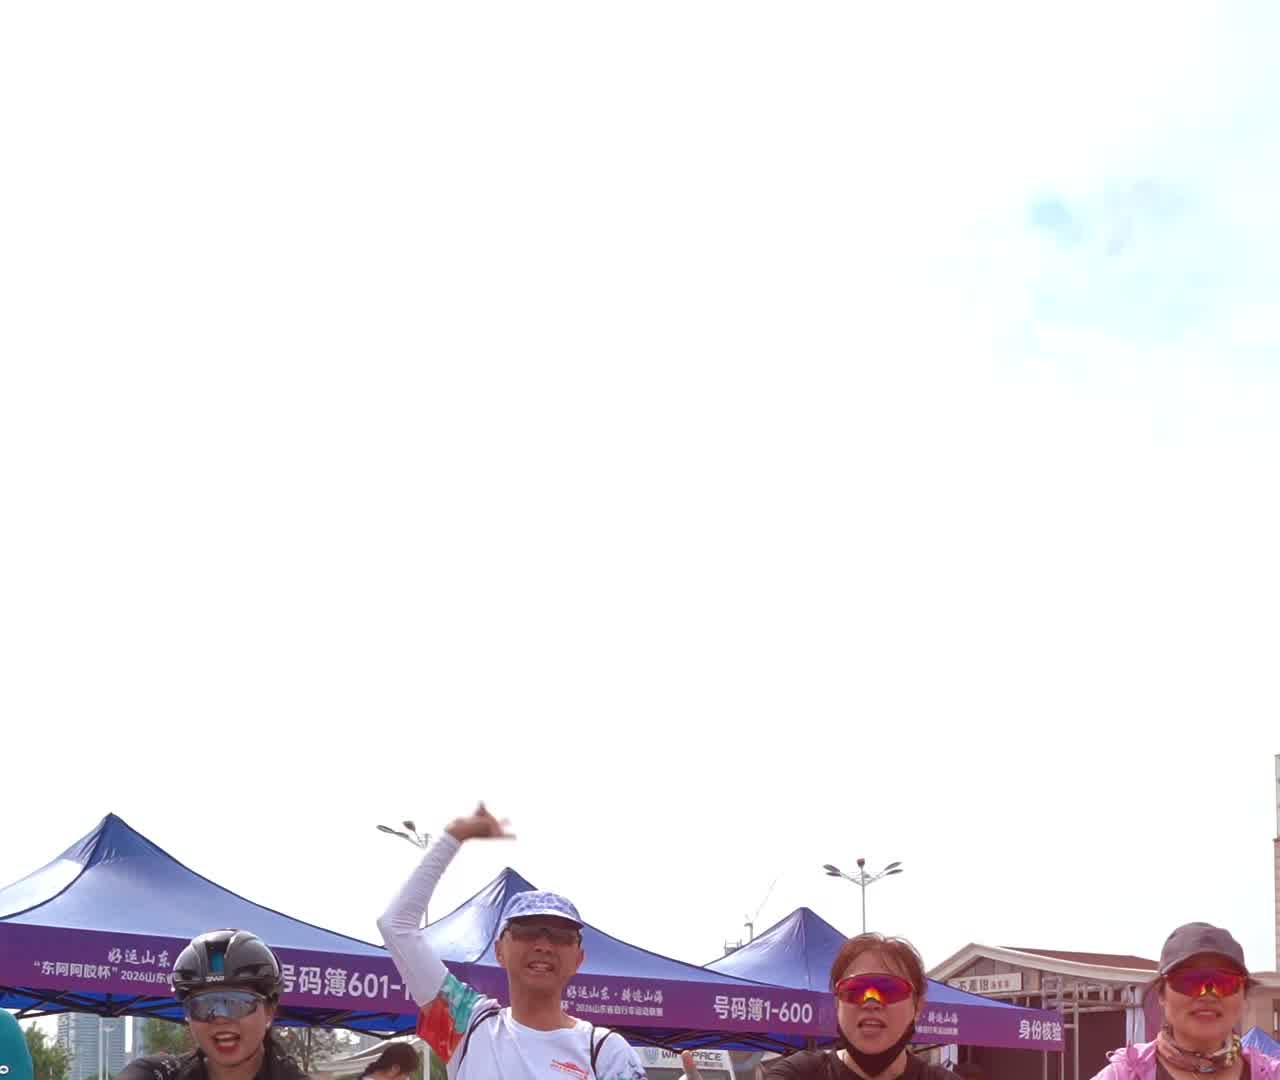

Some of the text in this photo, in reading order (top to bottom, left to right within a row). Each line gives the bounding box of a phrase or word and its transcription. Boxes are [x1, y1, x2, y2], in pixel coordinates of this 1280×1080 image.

[108, 947, 170, 968] 好运山东
[713, 995, 813, 1024] 号码簿1-600
[1019, 1019, 1061, 1041] 身份核验
